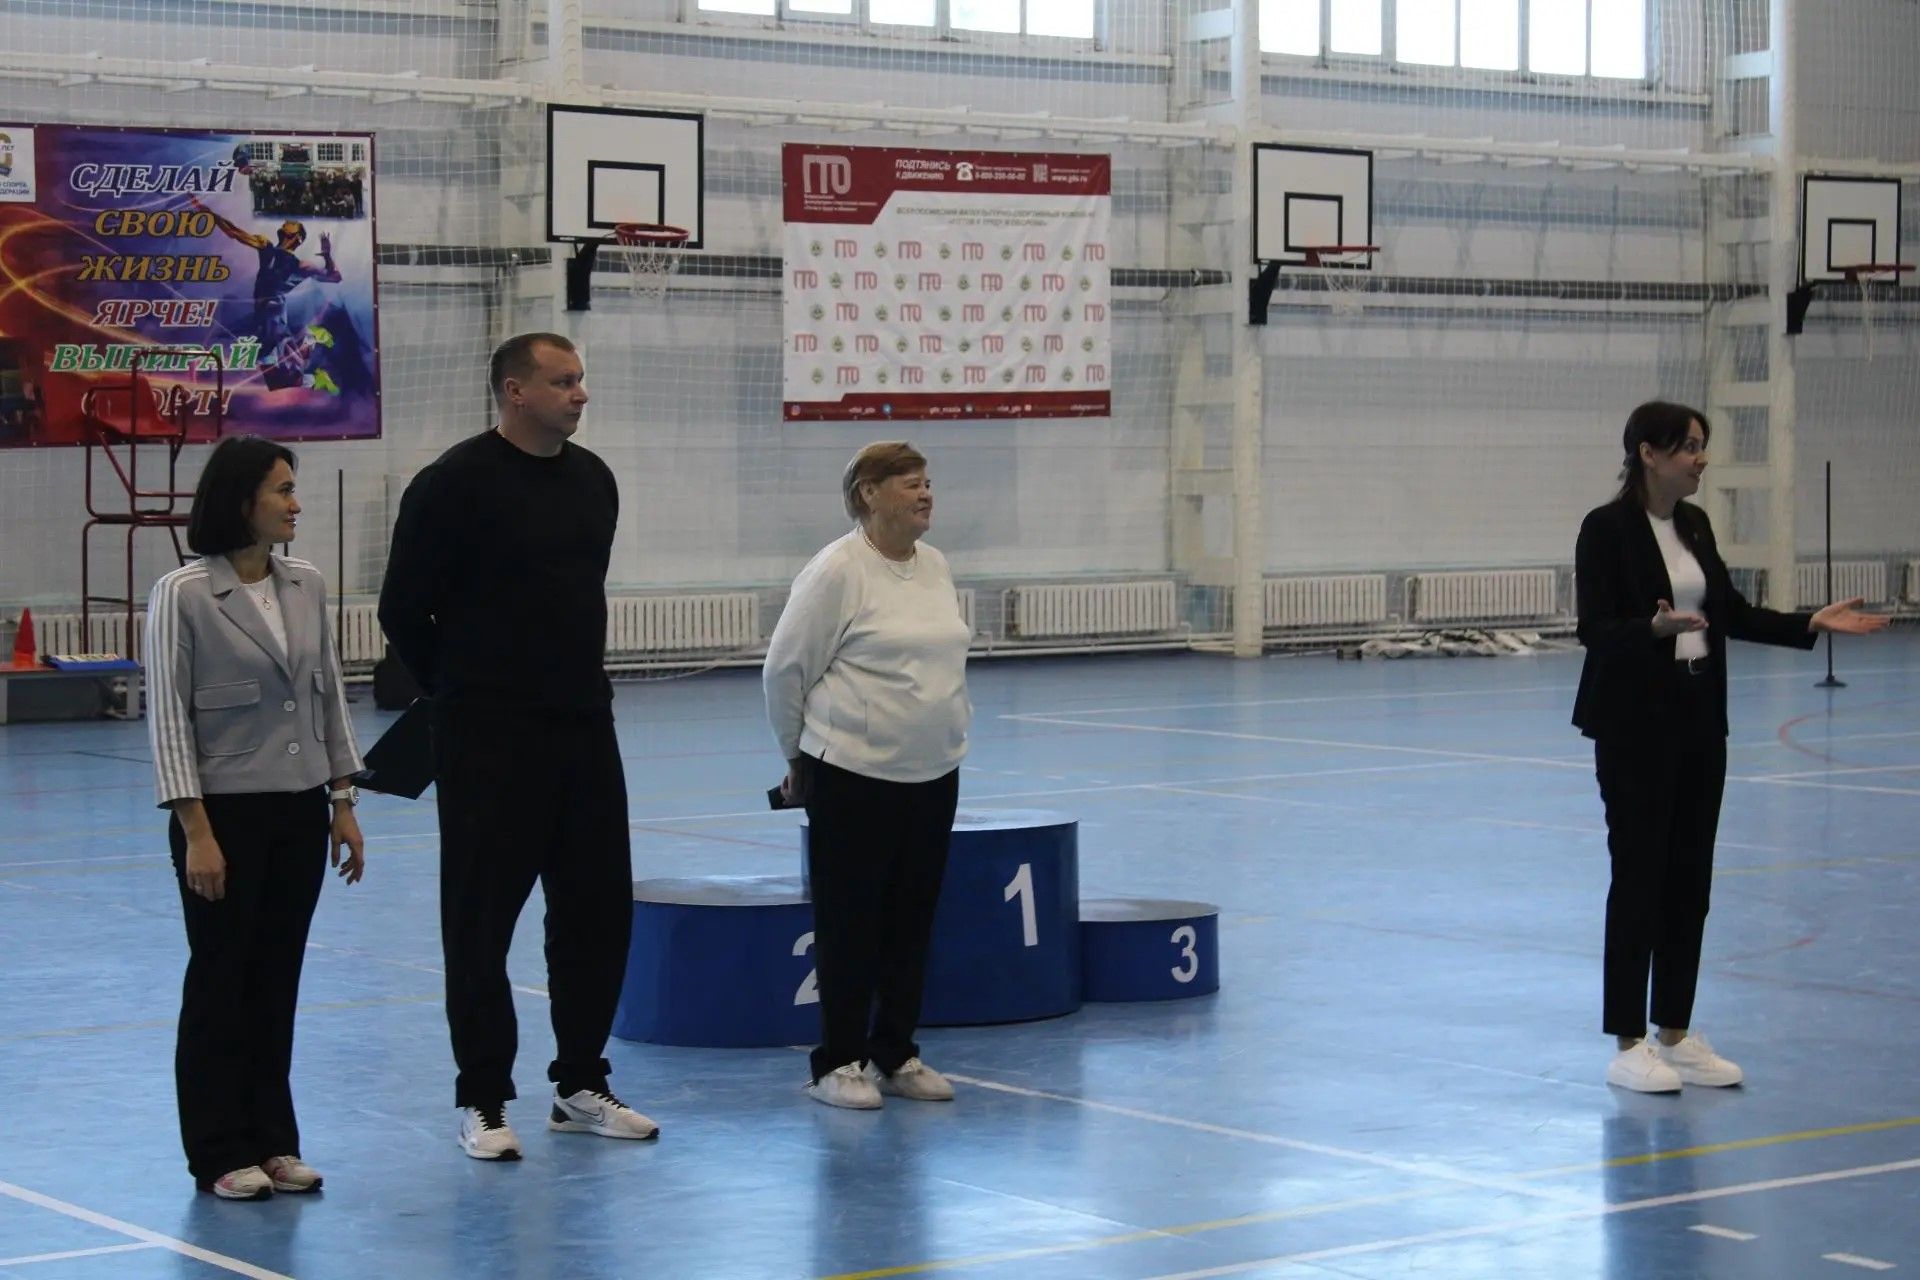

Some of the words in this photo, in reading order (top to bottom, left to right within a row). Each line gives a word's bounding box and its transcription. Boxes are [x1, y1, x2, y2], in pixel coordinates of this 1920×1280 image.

[802, 154, 851, 195] ГТО
[895, 159, 951, 171] ПОДТЯНИСЬ
[70, 161, 238, 198] СДЕЛАЙ
[94, 209, 217, 237] СВОЮ
[834, 240, 858, 258] ГТО
[898, 241, 922, 259] ГТО
[962, 242, 984, 261] ГТО
[1024, 243, 1045, 261] ГТО
[1083, 244, 1105, 261] ГТО
[76, 255, 230, 282] ЖИЗНЬ
[793, 270, 818, 289] ГТО
[854, 271, 878, 290] ГТО
[918, 273, 942, 291] ГТО
[981, 274, 1003, 291] ГТО
[1042, 274, 1065, 291] ГТО
[89, 299, 219, 327] ЯРЧЕ!
[836, 303, 859, 321] ГТО
[900, 304, 922, 322] ГТО
[963, 305, 985, 322] ГТО
[1024, 305, 1047, 322] ГТО
[1084, 305, 1105, 322] ГТО
[49, 336, 262, 372] ВЫБИРАЙ
[794, 334, 817, 352] ГТО
[855, 335, 879, 353] ГТО
[919, 335, 942, 353] ГТО
[982, 335, 1004, 353] ГТО
[1043, 335, 1064, 352] ГТО
[836, 366, 860, 384] ГТО
[900, 366, 924, 384] ГТО
[964, 366, 986, 384] ГТО
[1025, 365, 1046, 383] ГТО
[1086, 365, 1105, 383] ГТО
[1004, 863, 1039, 947] 1
[792, 931, 821, 1006] 2
[1170, 925, 1199, 984] 3
